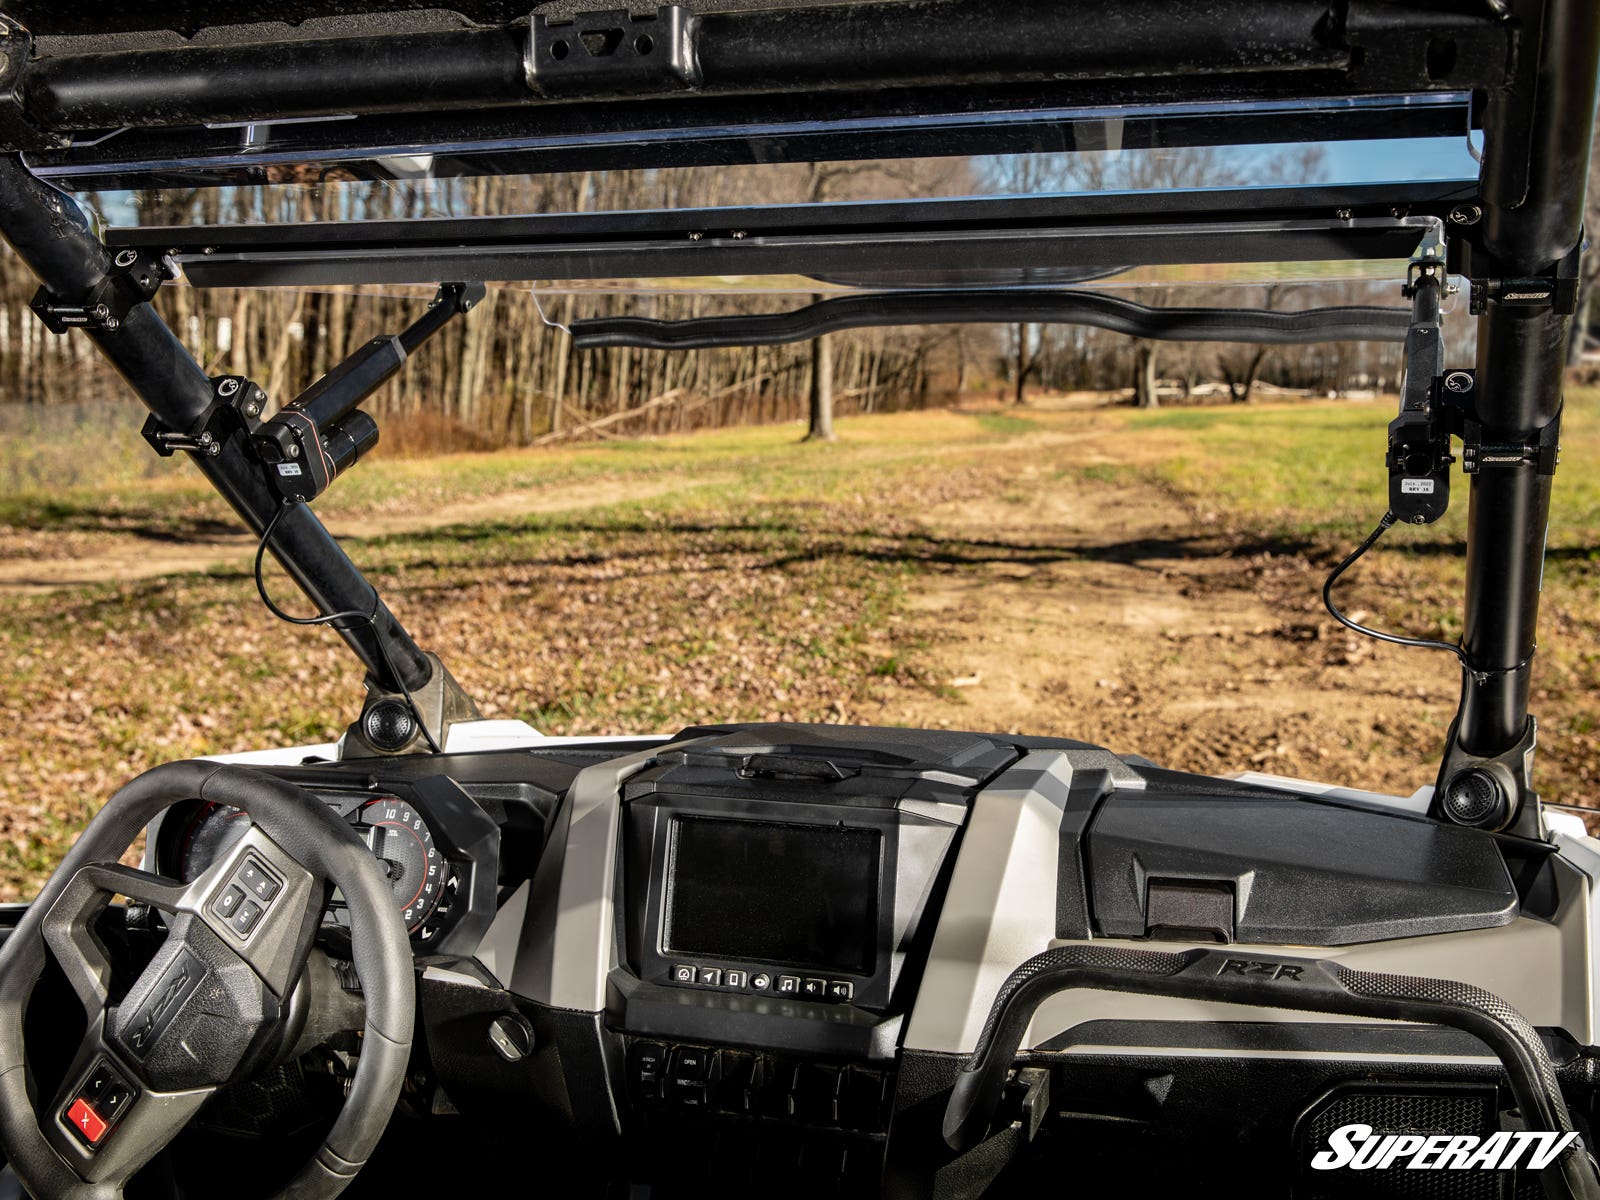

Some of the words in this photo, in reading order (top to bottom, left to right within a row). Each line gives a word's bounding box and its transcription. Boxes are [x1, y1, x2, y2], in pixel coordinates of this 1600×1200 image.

[385, 809, 396, 819] 10
[403, 812, 410, 822] 9
[413, 820, 421, 830] 8
[424, 832, 431, 842] 7
[428, 848, 436, 858] 6
[428, 865, 436, 876] 5
[425, 883, 432, 894] 4
[417, 899, 424, 909] 3
[405, 910, 412, 920] 2
[1216, 959, 1304, 981] RZR
